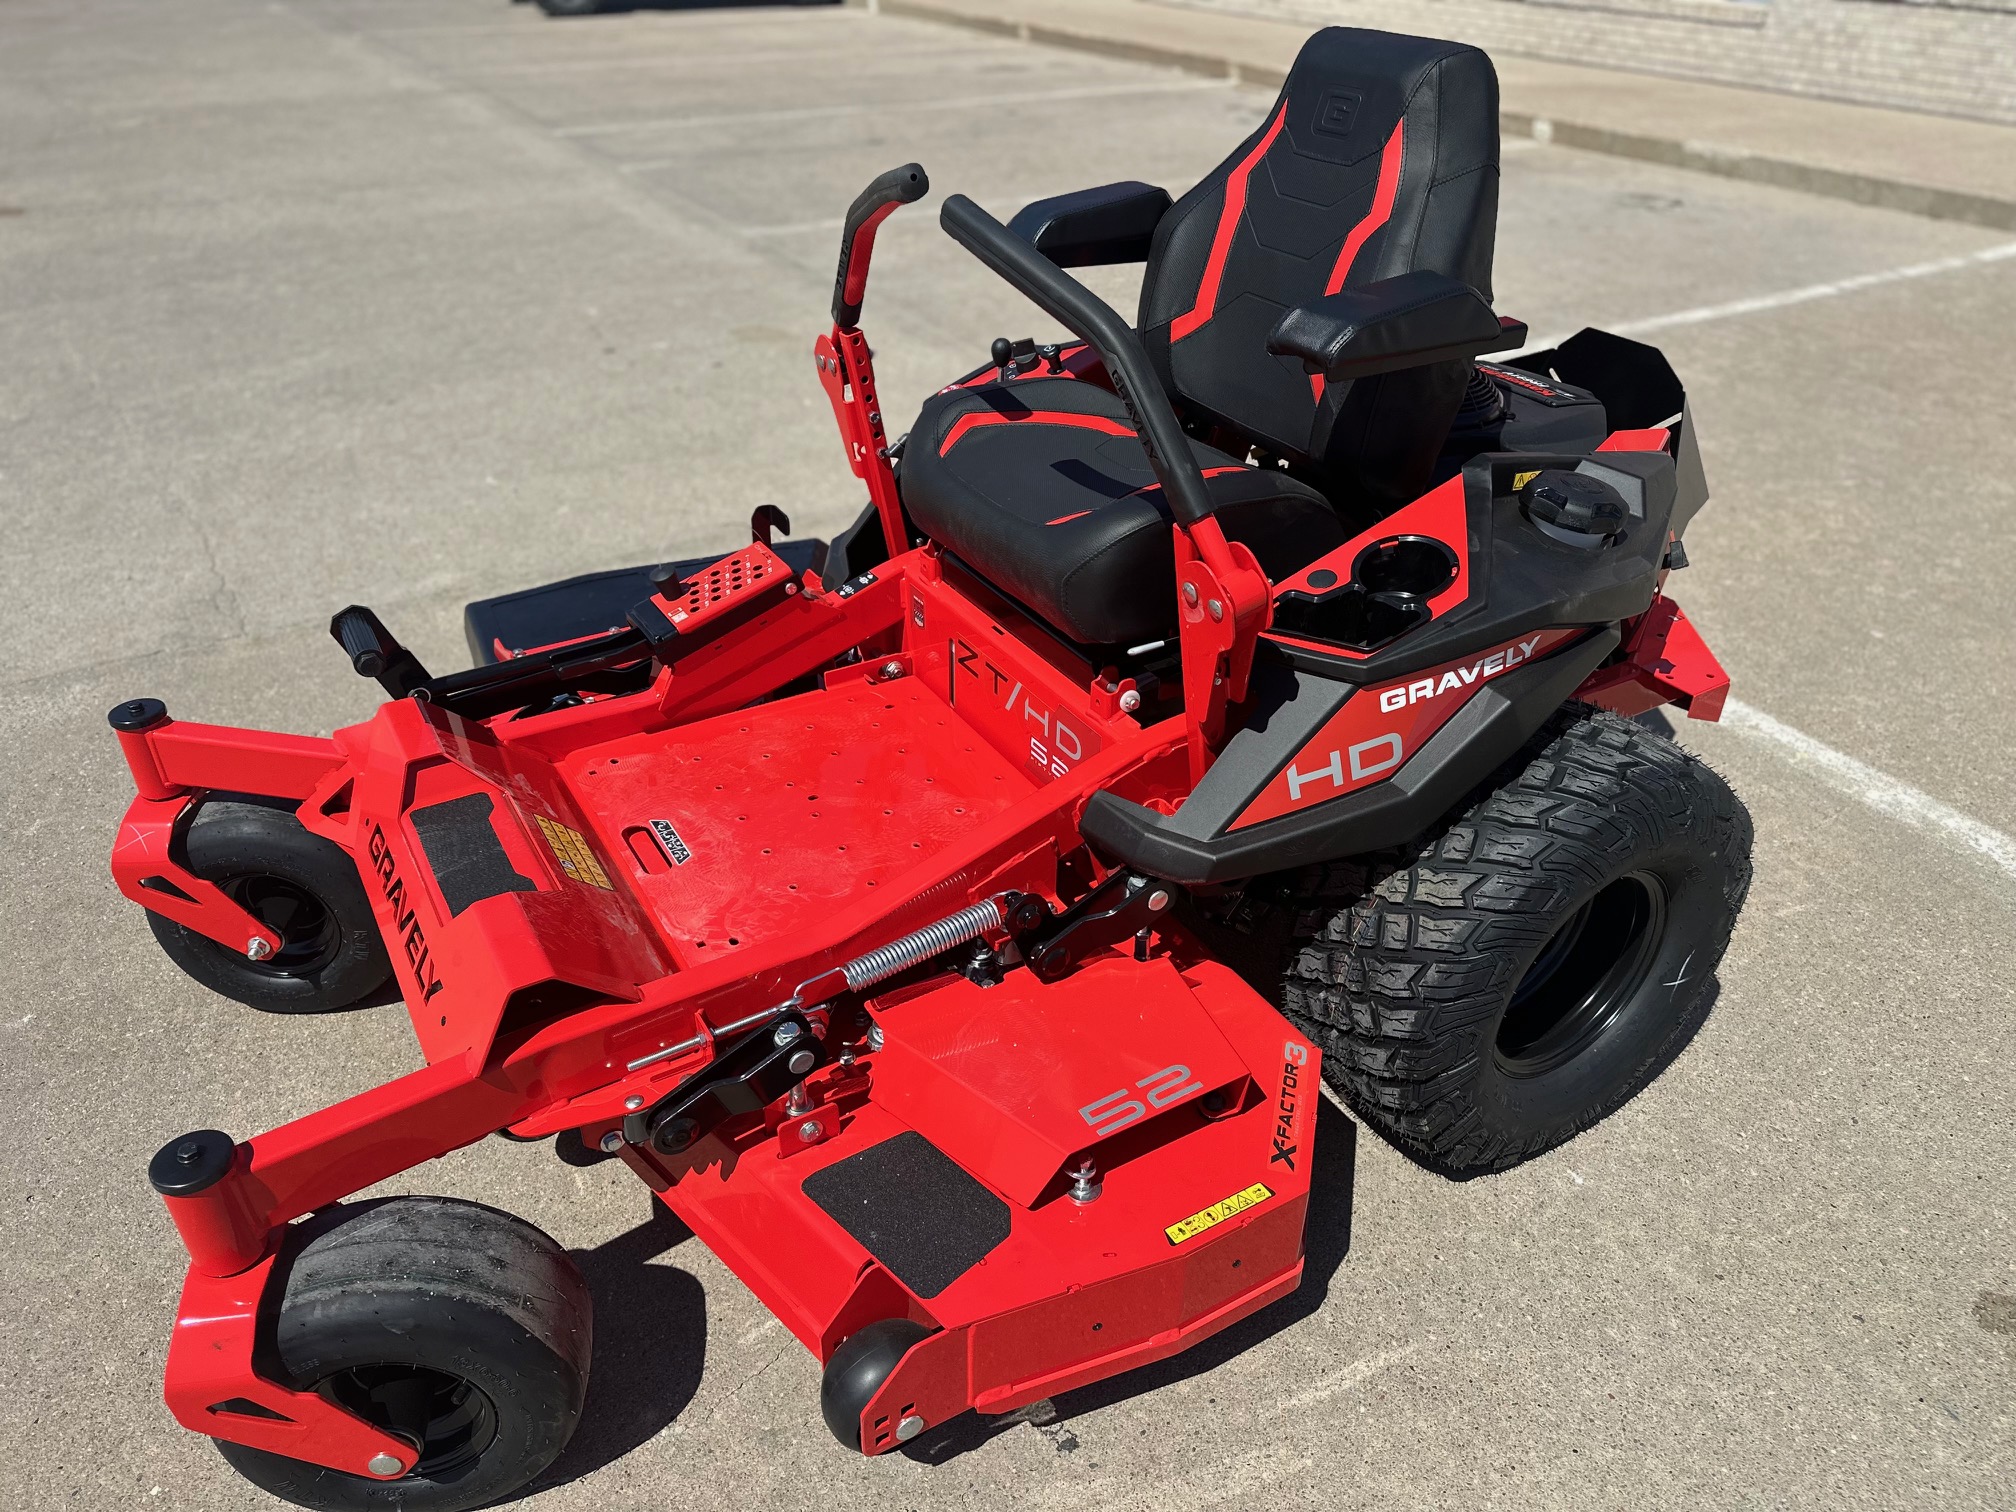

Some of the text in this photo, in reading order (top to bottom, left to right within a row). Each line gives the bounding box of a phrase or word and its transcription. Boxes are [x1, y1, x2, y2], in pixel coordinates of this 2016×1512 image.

[957, 638, 1082, 761] ZT/HD
[1380, 634, 1542, 713] GRAVELY
[1286, 732, 1403, 801] HD
[368, 823, 444, 1007] GRAVELY
[1078, 1064, 1204, 1137] 52
